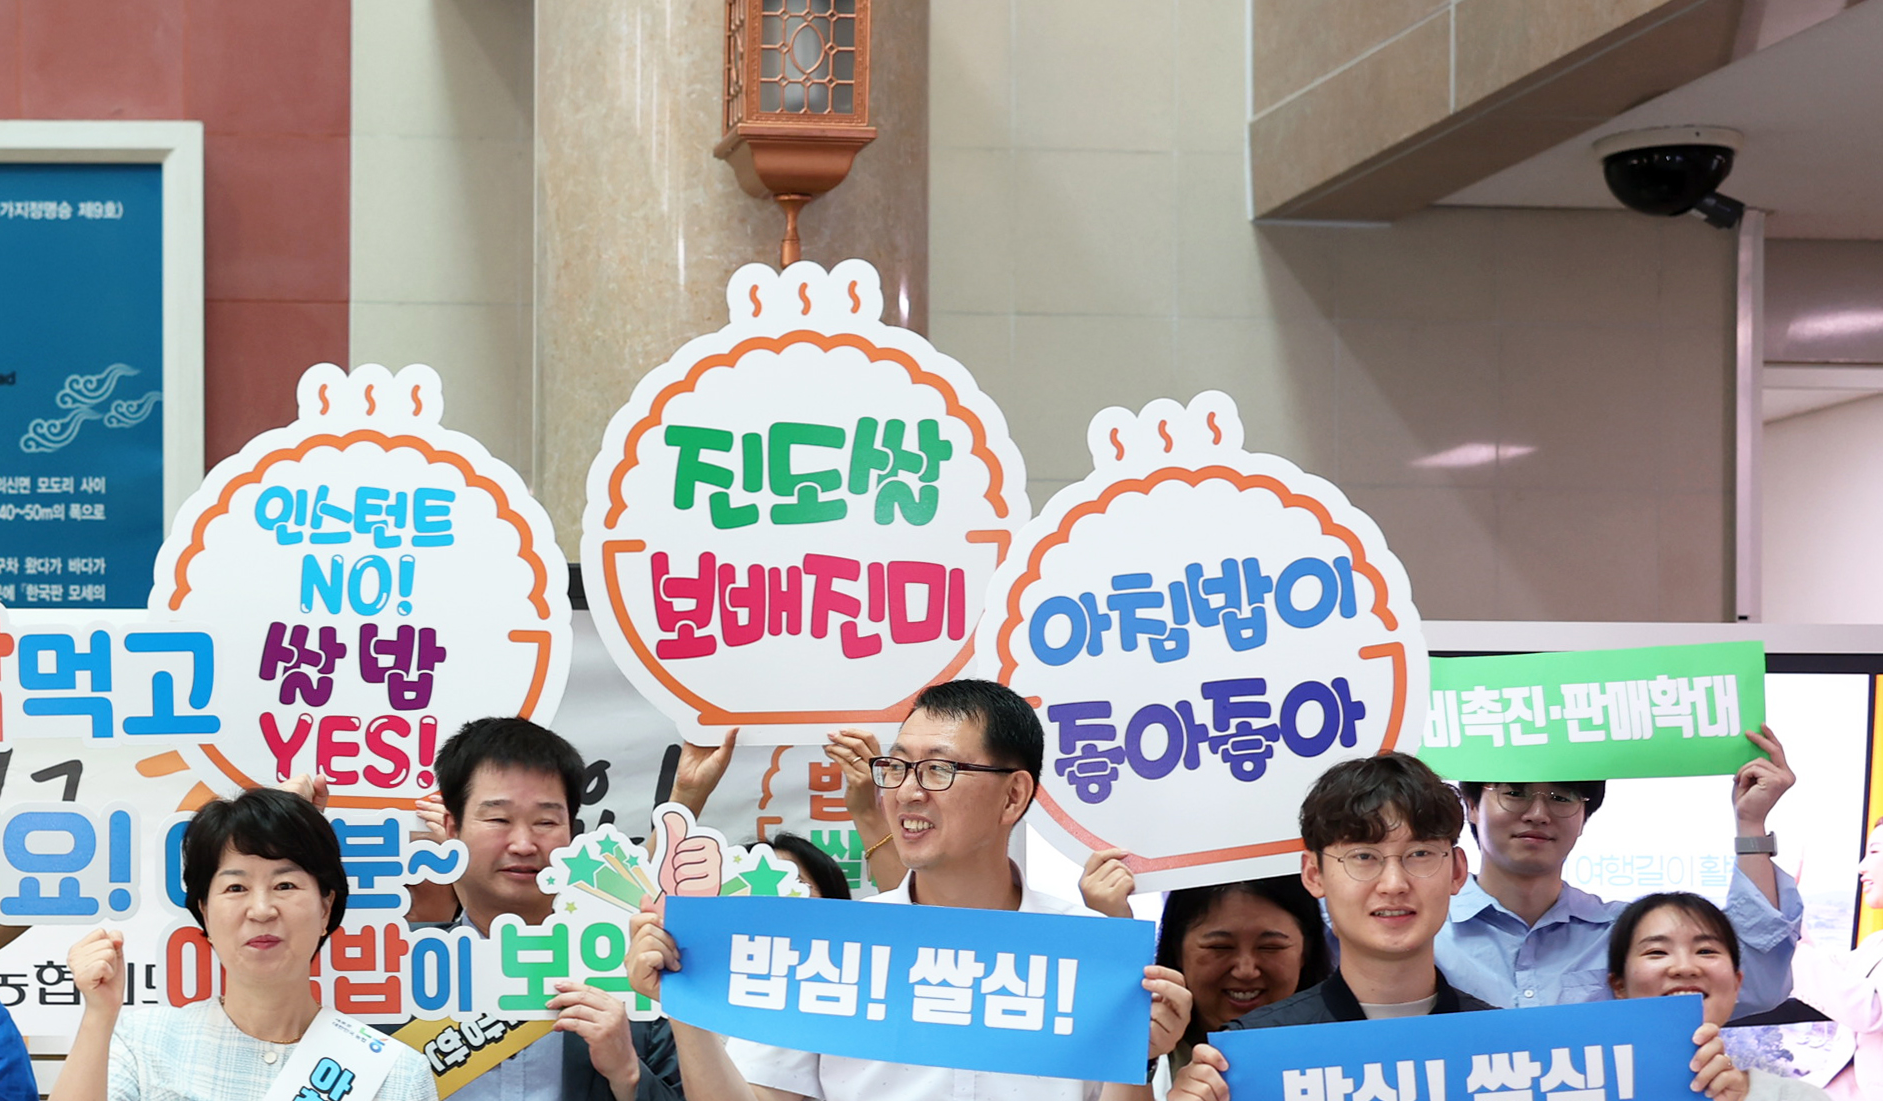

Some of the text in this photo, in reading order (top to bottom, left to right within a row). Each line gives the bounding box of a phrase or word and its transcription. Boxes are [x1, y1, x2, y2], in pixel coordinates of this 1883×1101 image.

[78, 200, 123, 220] 제9호)
[37, 476, 74, 495] 모도리
[80, 476, 106, 495] 사이
[663, 415, 953, 531] 진도쌀
[69, 503, 106, 521] 폭으로
[254, 484, 457, 549] 인스턴트
[25, 556, 62, 575] 왔다가
[68, 556, 106, 575] 바다가
[68, 583, 106, 602] 모세의
[300, 554, 415, 616] NO!
[651, 551, 966, 660] 보배진미
[1028, 554, 1357, 667] 아침밥이
[259, 620, 447, 711] 쌀 밥
[259, 712, 437, 790] YES!
[1046, 675, 1366, 805] 좋아좋아
[727, 932, 1078, 1036] 밥심! 쌀심!
